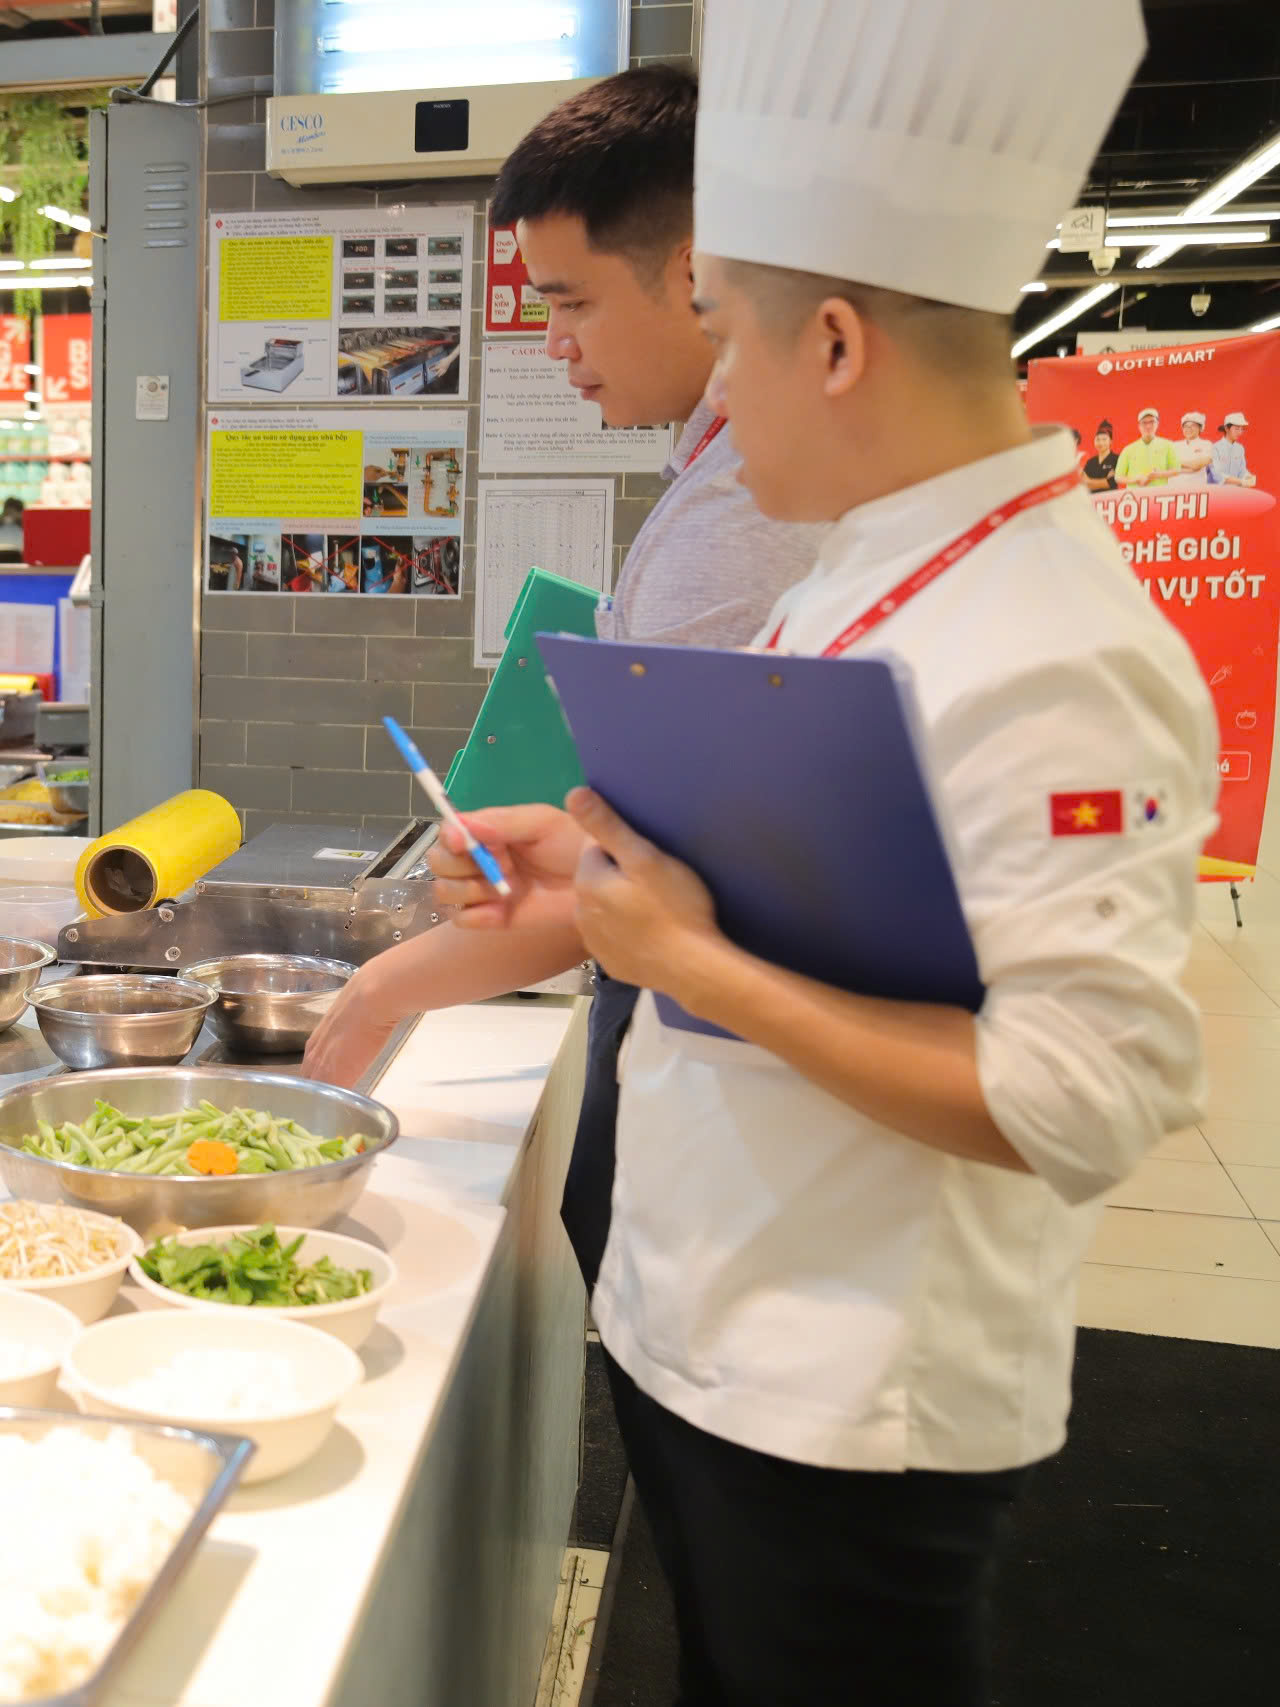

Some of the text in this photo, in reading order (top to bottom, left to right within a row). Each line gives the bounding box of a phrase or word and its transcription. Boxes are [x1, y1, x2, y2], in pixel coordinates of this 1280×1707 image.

[280, 113, 324, 132] CESCO
[1115, 349, 1216, 372] LOTTE MART
[1096, 491, 1209, 531] HỘI THI
[1120, 529, 1240, 563] GHỀ GIỎI
[1157, 577, 1199, 607] VỤ
[1205, 568, 1266, 600] TỐT
